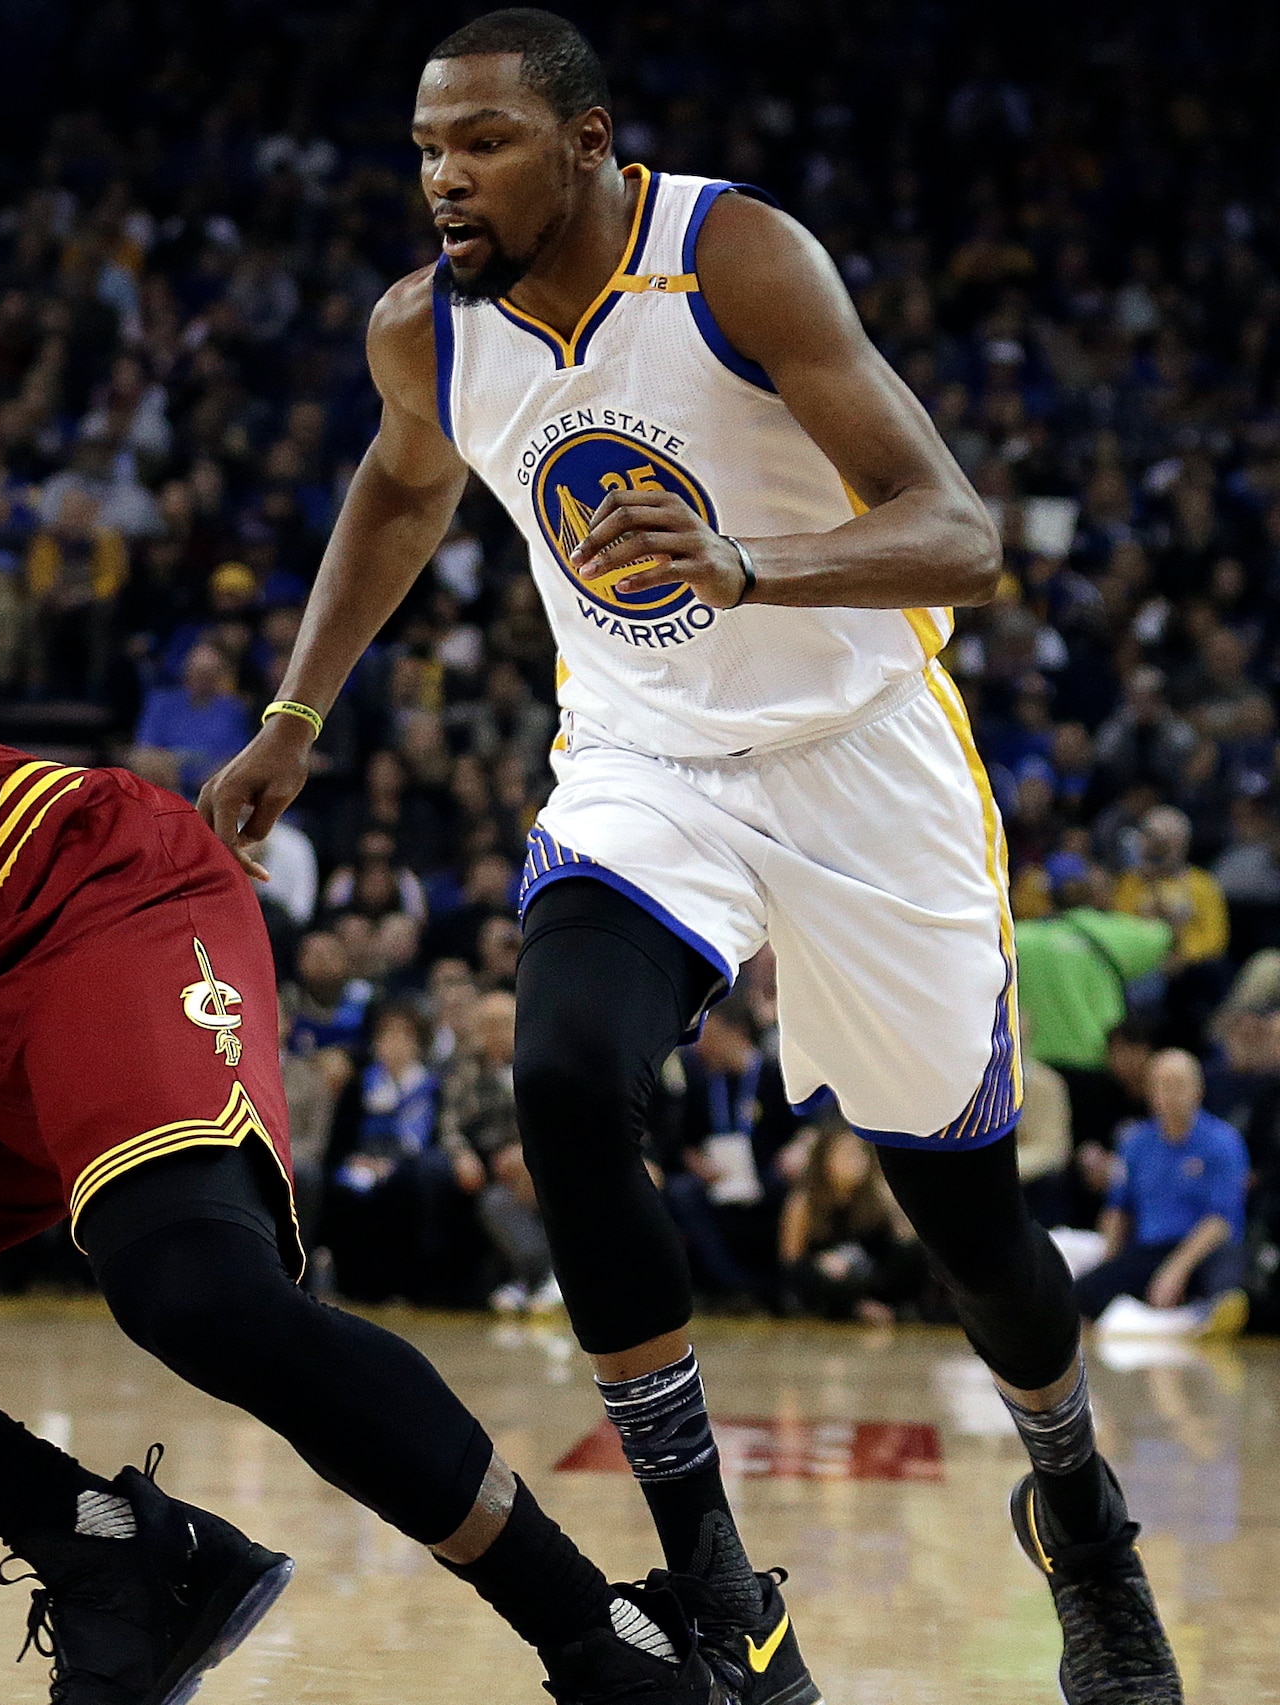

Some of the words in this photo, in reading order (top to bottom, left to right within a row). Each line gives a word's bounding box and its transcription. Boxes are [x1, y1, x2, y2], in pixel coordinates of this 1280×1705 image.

[517, 408, 595, 486] GOLDEN
[603, 410, 685, 456] STATE
[576, 596, 715, 648] WARRIO
